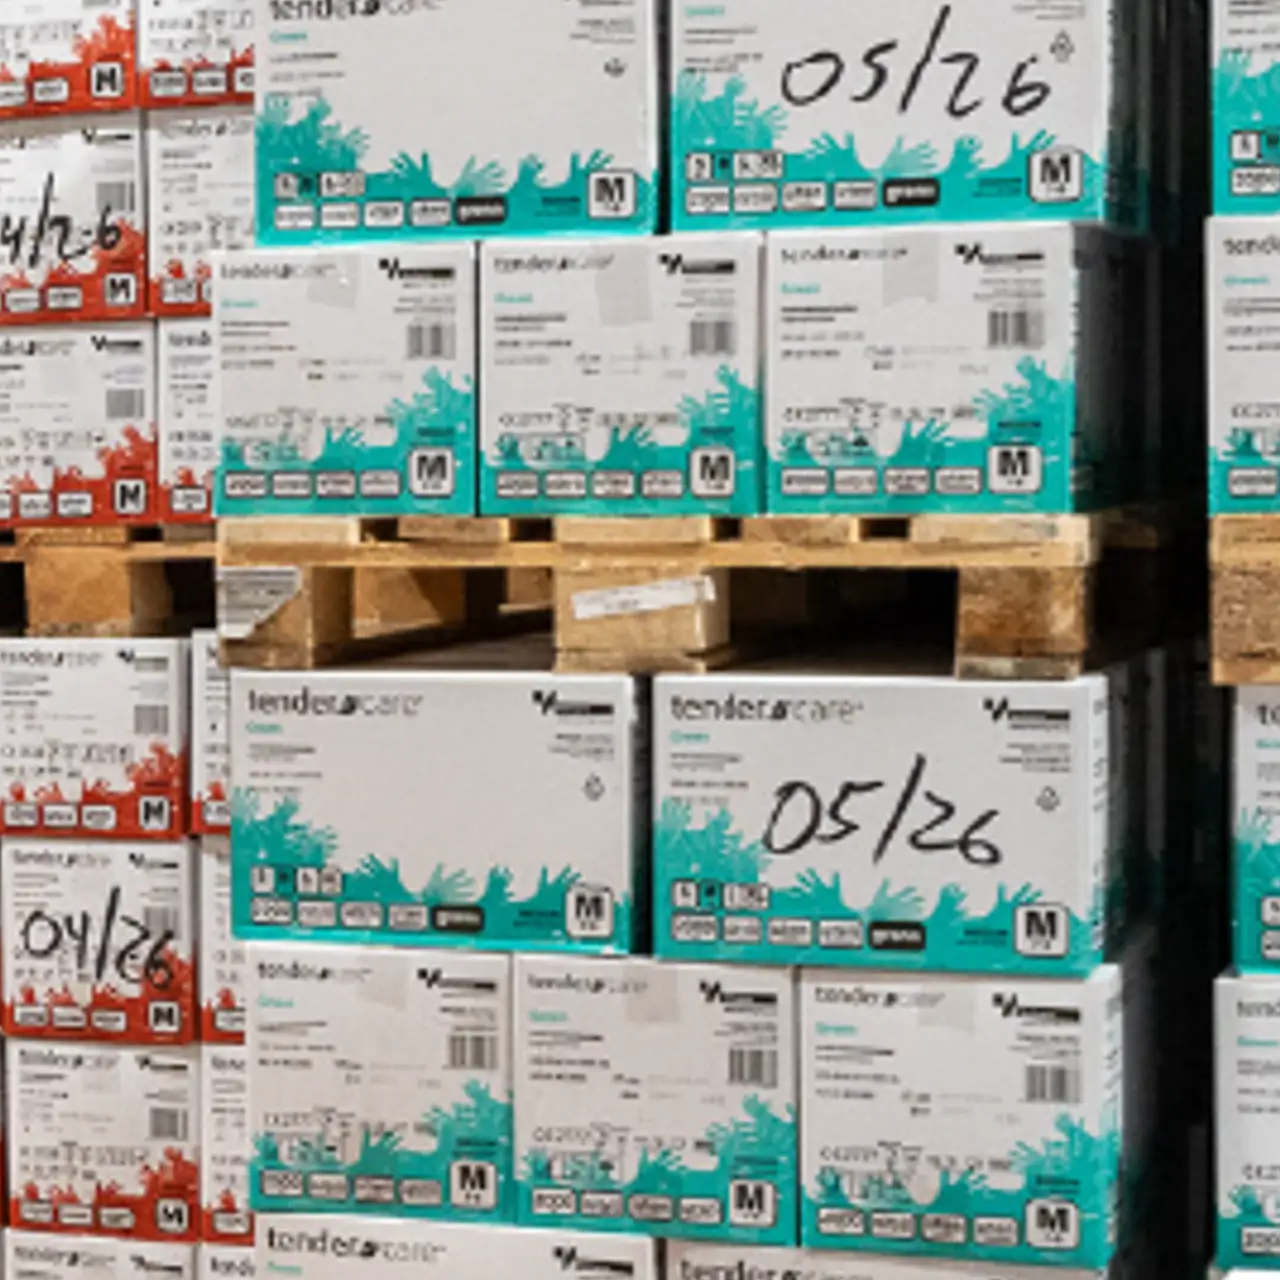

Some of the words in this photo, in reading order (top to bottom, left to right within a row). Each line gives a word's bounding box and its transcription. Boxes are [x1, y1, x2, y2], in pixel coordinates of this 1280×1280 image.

[781, 4, 1051, 118] 05/26
[1041, 155, 1070, 182] M
[597, 177, 625, 202] M
[999, 450, 1028, 476] M
[671, 693, 767, 720] tender
[761, 754, 1001, 865] 05/26
[575, 895, 603, 918] M
[20, 885, 176, 990] 04/26
[1026, 911, 1056, 938] M
[460, 1165, 486, 1190] M
[736, 1184, 764, 1211] M
[1038, 1207, 1068, 1231] M
